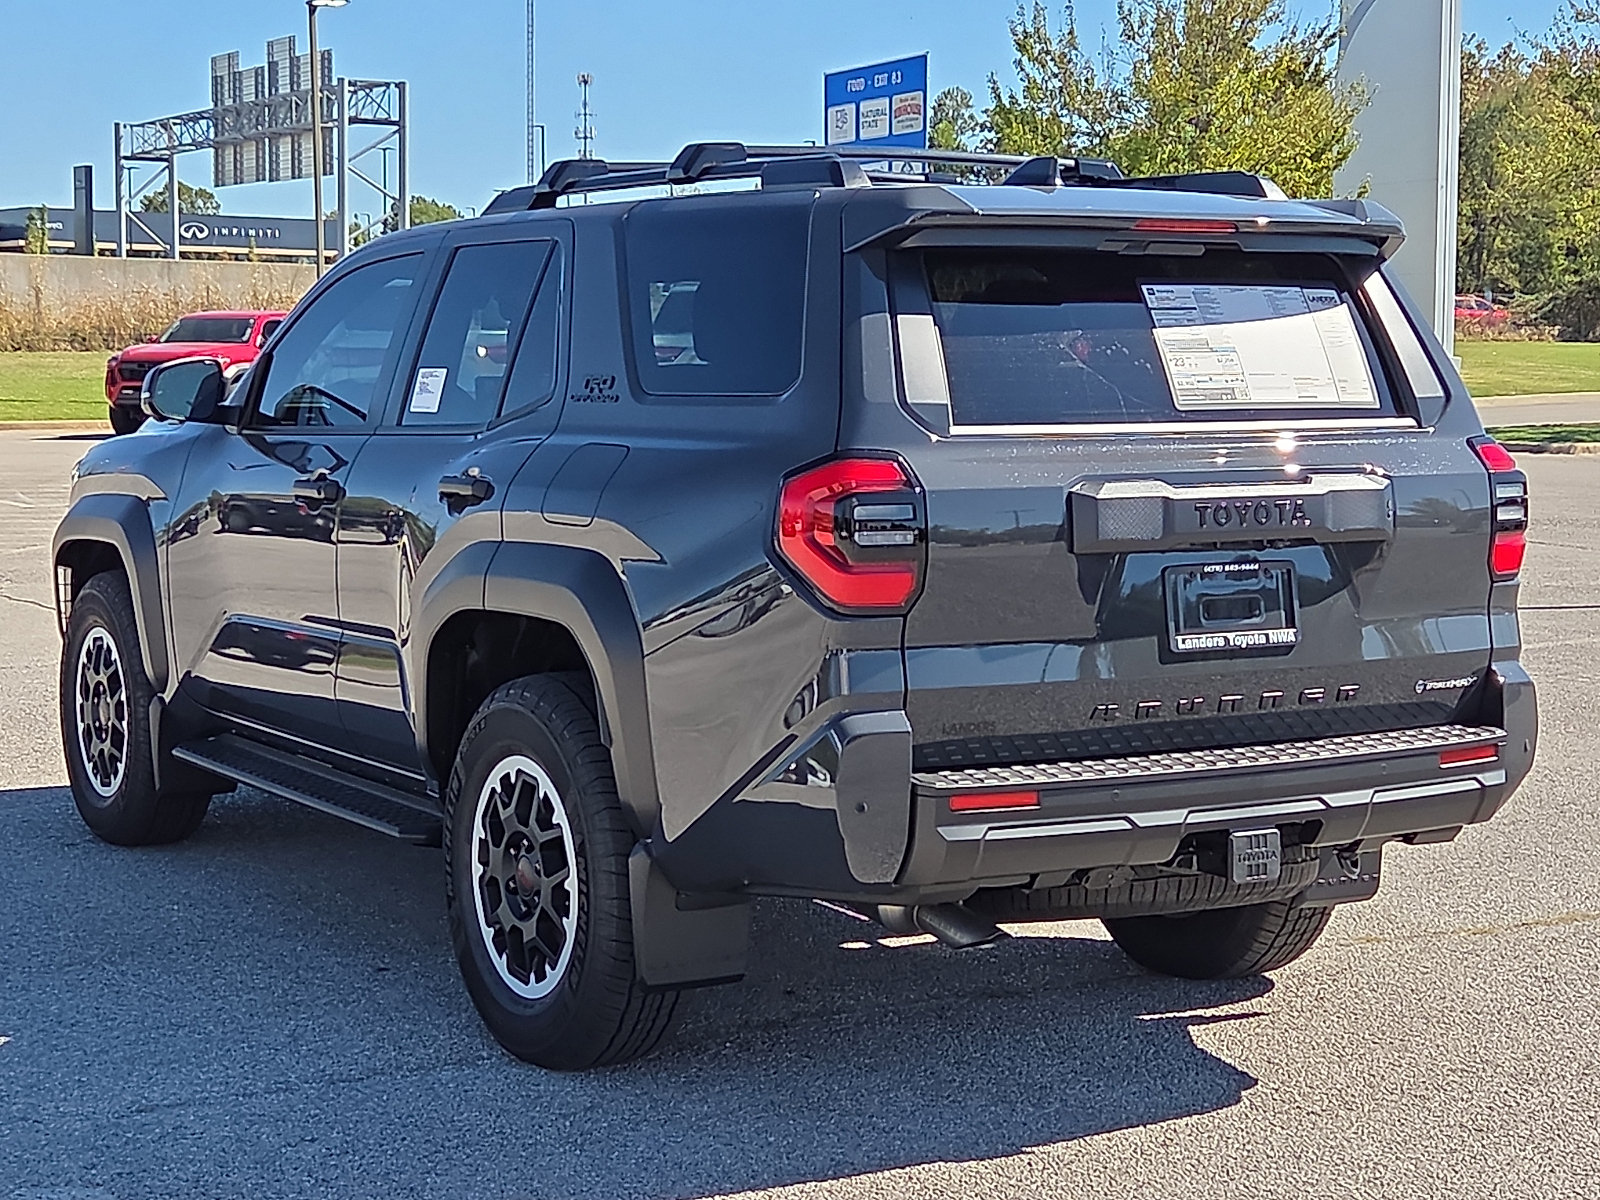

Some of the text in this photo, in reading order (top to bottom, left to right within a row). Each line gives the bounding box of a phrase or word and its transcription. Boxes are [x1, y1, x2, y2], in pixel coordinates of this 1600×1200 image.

[874, 72, 889, 88] EXIT
[861, 119, 879, 130] STATE
[213, 226, 280, 238] INFINITI
[1194, 499, 1312, 528] TOYOTA
[1177, 630, 1297, 650] Landers Toyota NWA
[1237, 849, 1278, 864] TOYOTA
